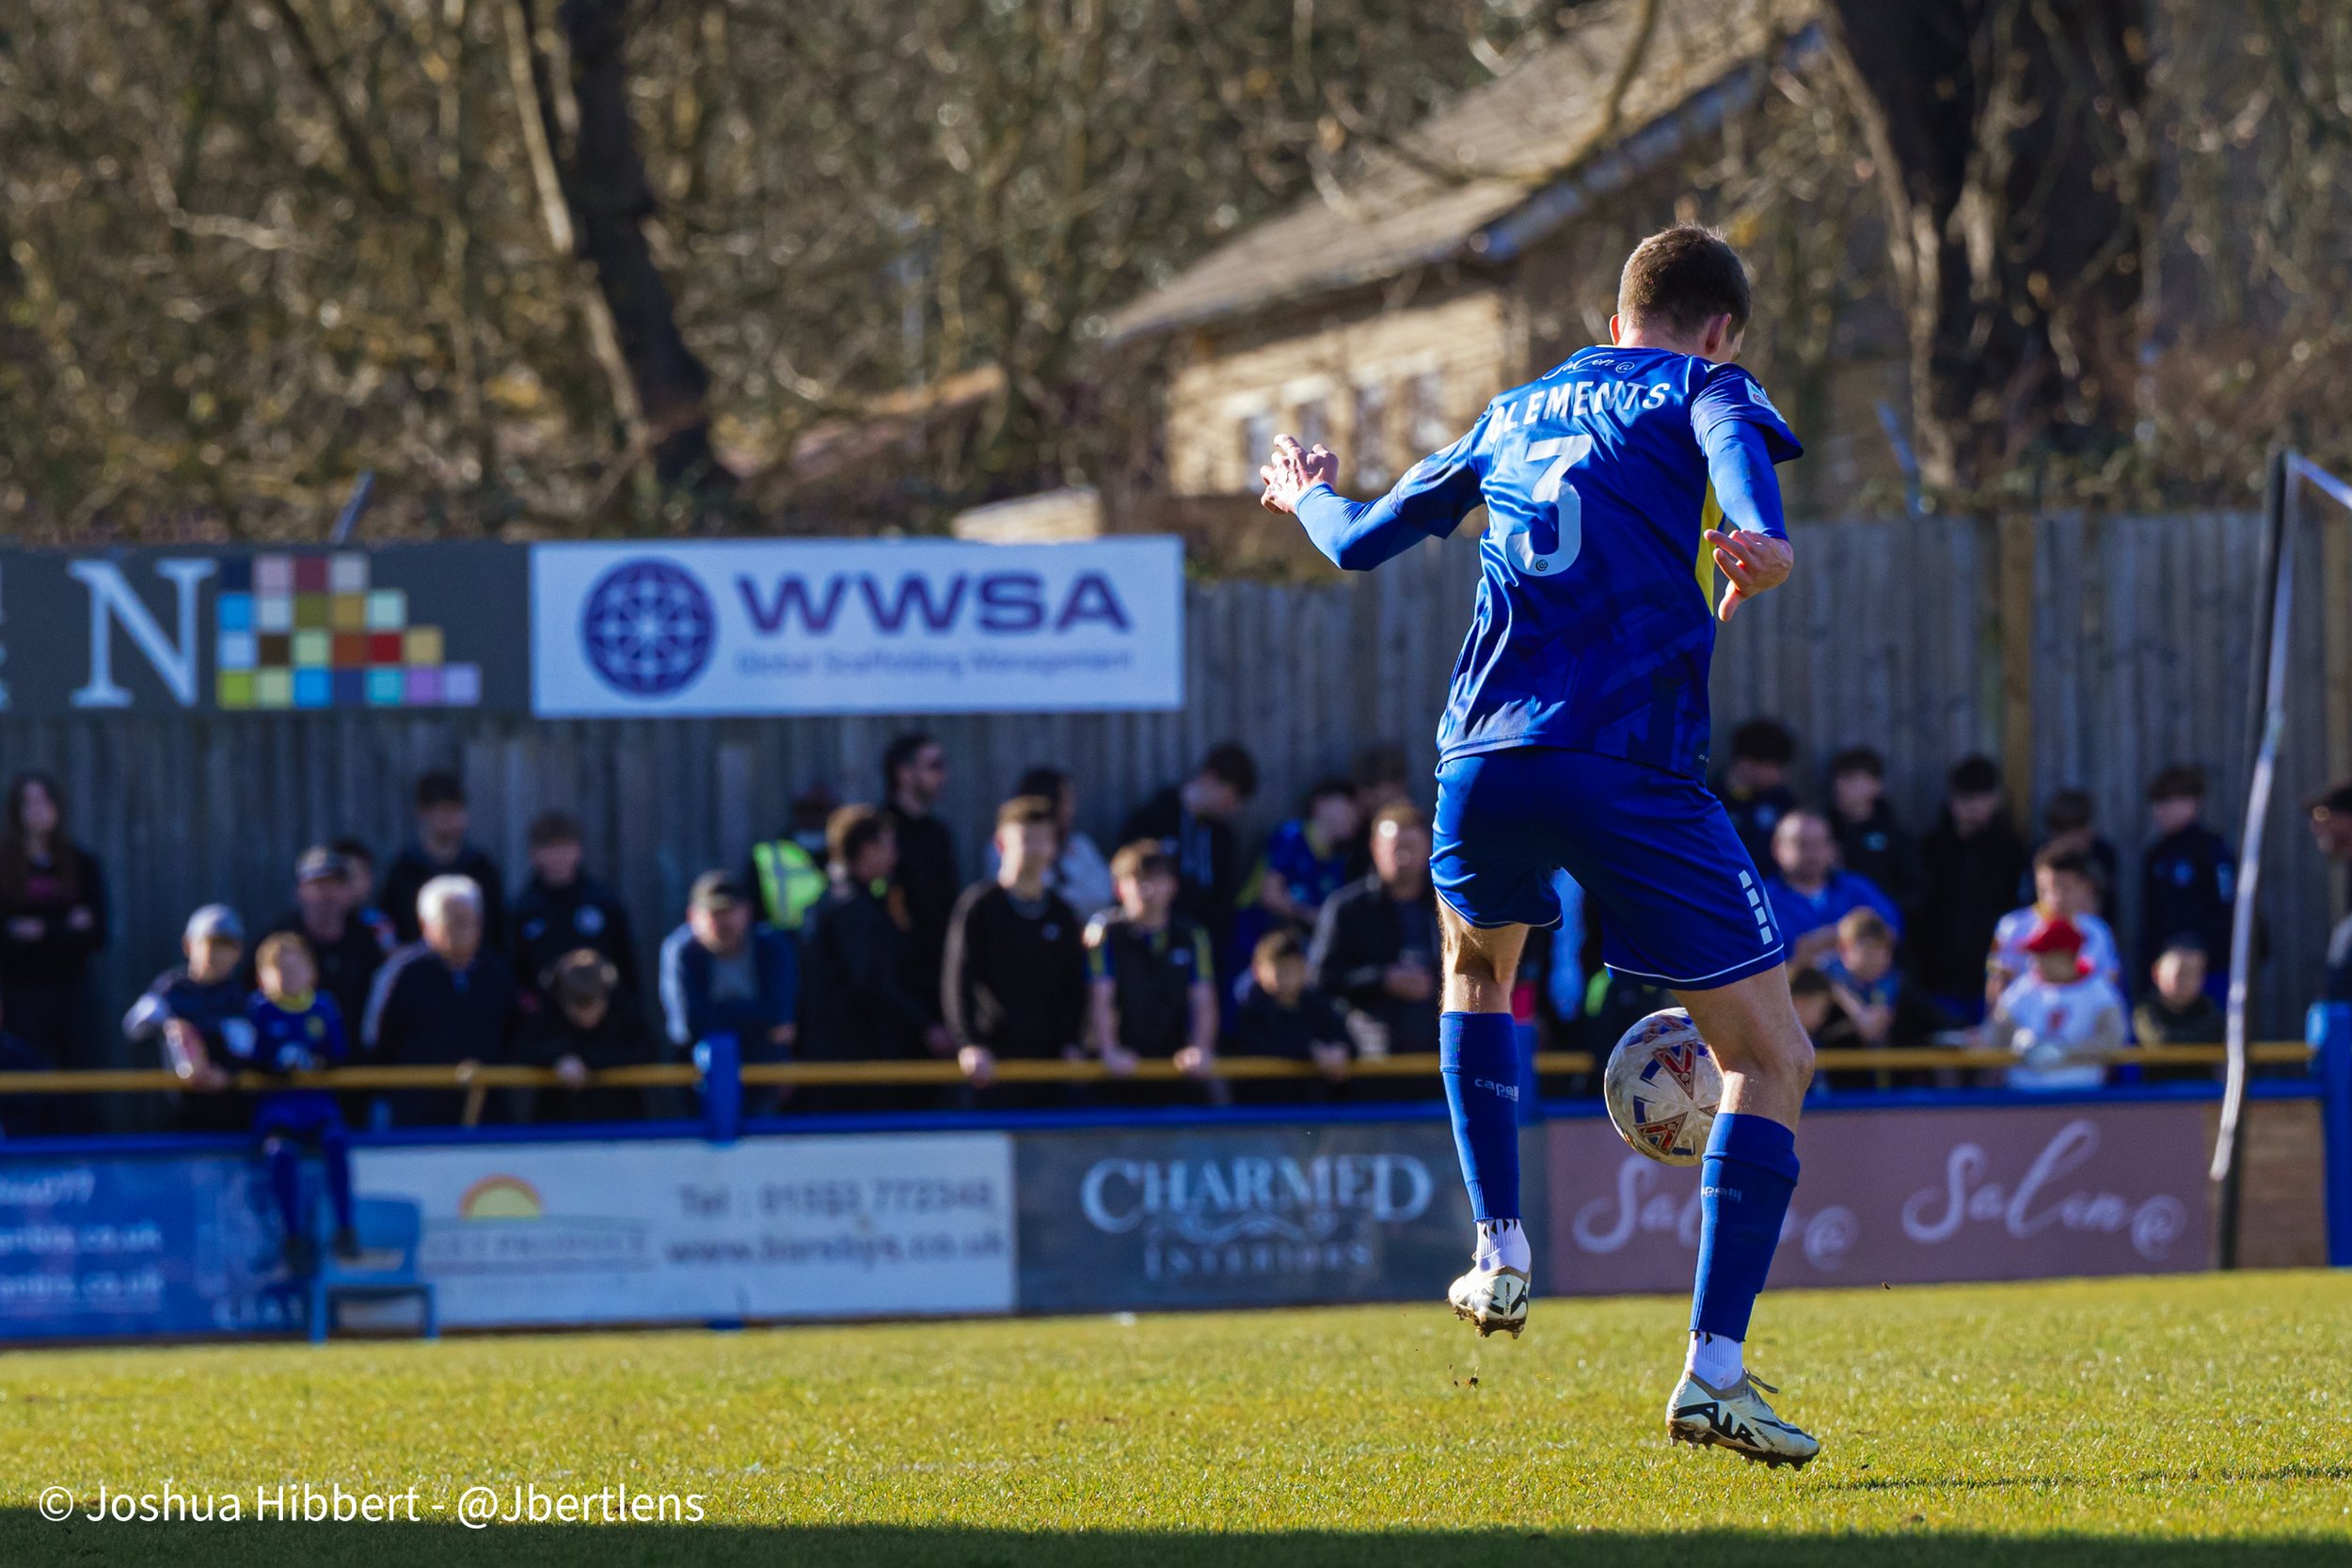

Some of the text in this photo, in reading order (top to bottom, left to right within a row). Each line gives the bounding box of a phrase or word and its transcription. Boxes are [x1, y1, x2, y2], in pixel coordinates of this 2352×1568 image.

[1487, 380, 1671, 443] CLEMENTS
[1505, 434, 1592, 577] 3
[736, 570, 1130, 634] WWSA
[1081, 1155, 1434, 1234] CHARMED
